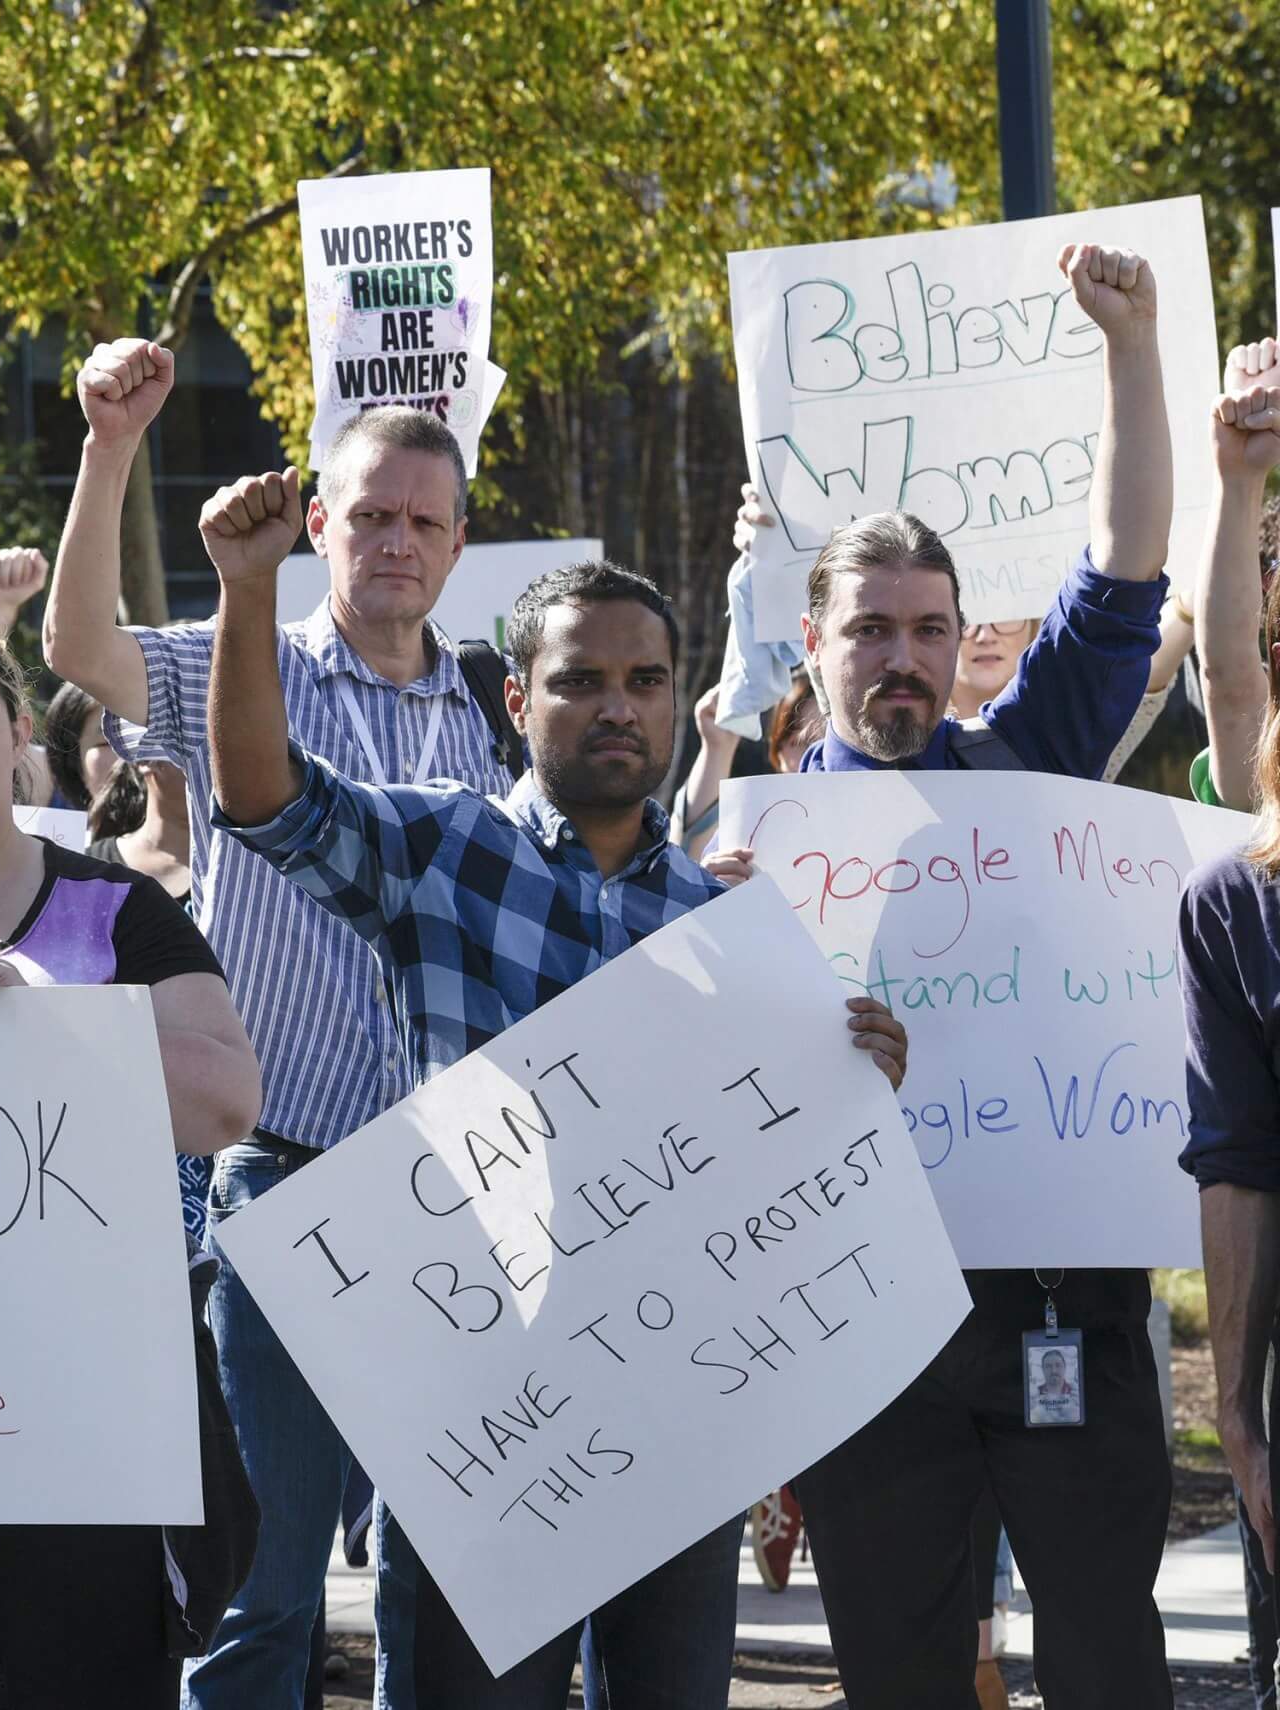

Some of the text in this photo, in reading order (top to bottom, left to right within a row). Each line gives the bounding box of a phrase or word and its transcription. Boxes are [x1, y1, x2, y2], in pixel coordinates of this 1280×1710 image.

[320, 219, 473, 266] WORKER'S
[349, 264, 454, 310] RIGHTS
[381, 311, 434, 351] ARE
[335, 352, 468, 399] WOMEN'S
[755, 415, 1100, 552] Wome
[1053, 819, 1182, 899] Men
[1063, 948, 1177, 1005] wit
[292, 1052, 601, 1298] I CAN'T
[411, 1067, 801, 1333] BELIEVE I
[426, 1128, 888, 1498] HAVE TO PROTEST
[498, 1427, 635, 1532] THIS
